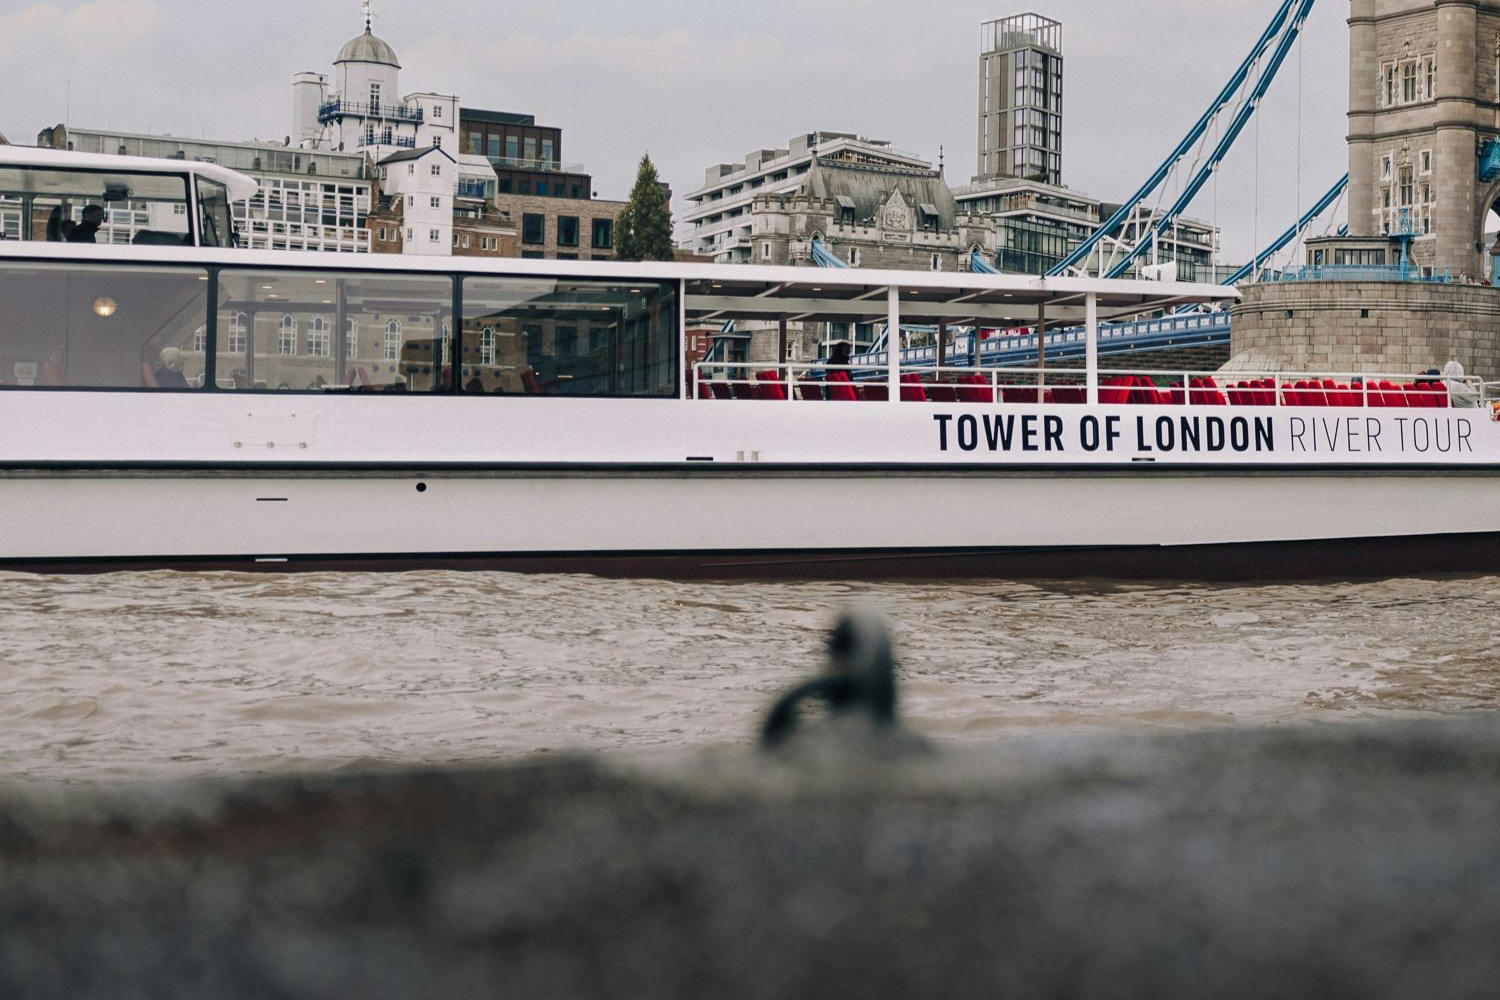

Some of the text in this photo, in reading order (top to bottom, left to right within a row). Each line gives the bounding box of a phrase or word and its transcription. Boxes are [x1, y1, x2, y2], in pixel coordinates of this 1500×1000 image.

[932, 413, 1474, 454] TOWER OF LONDON RIVER TOUR
